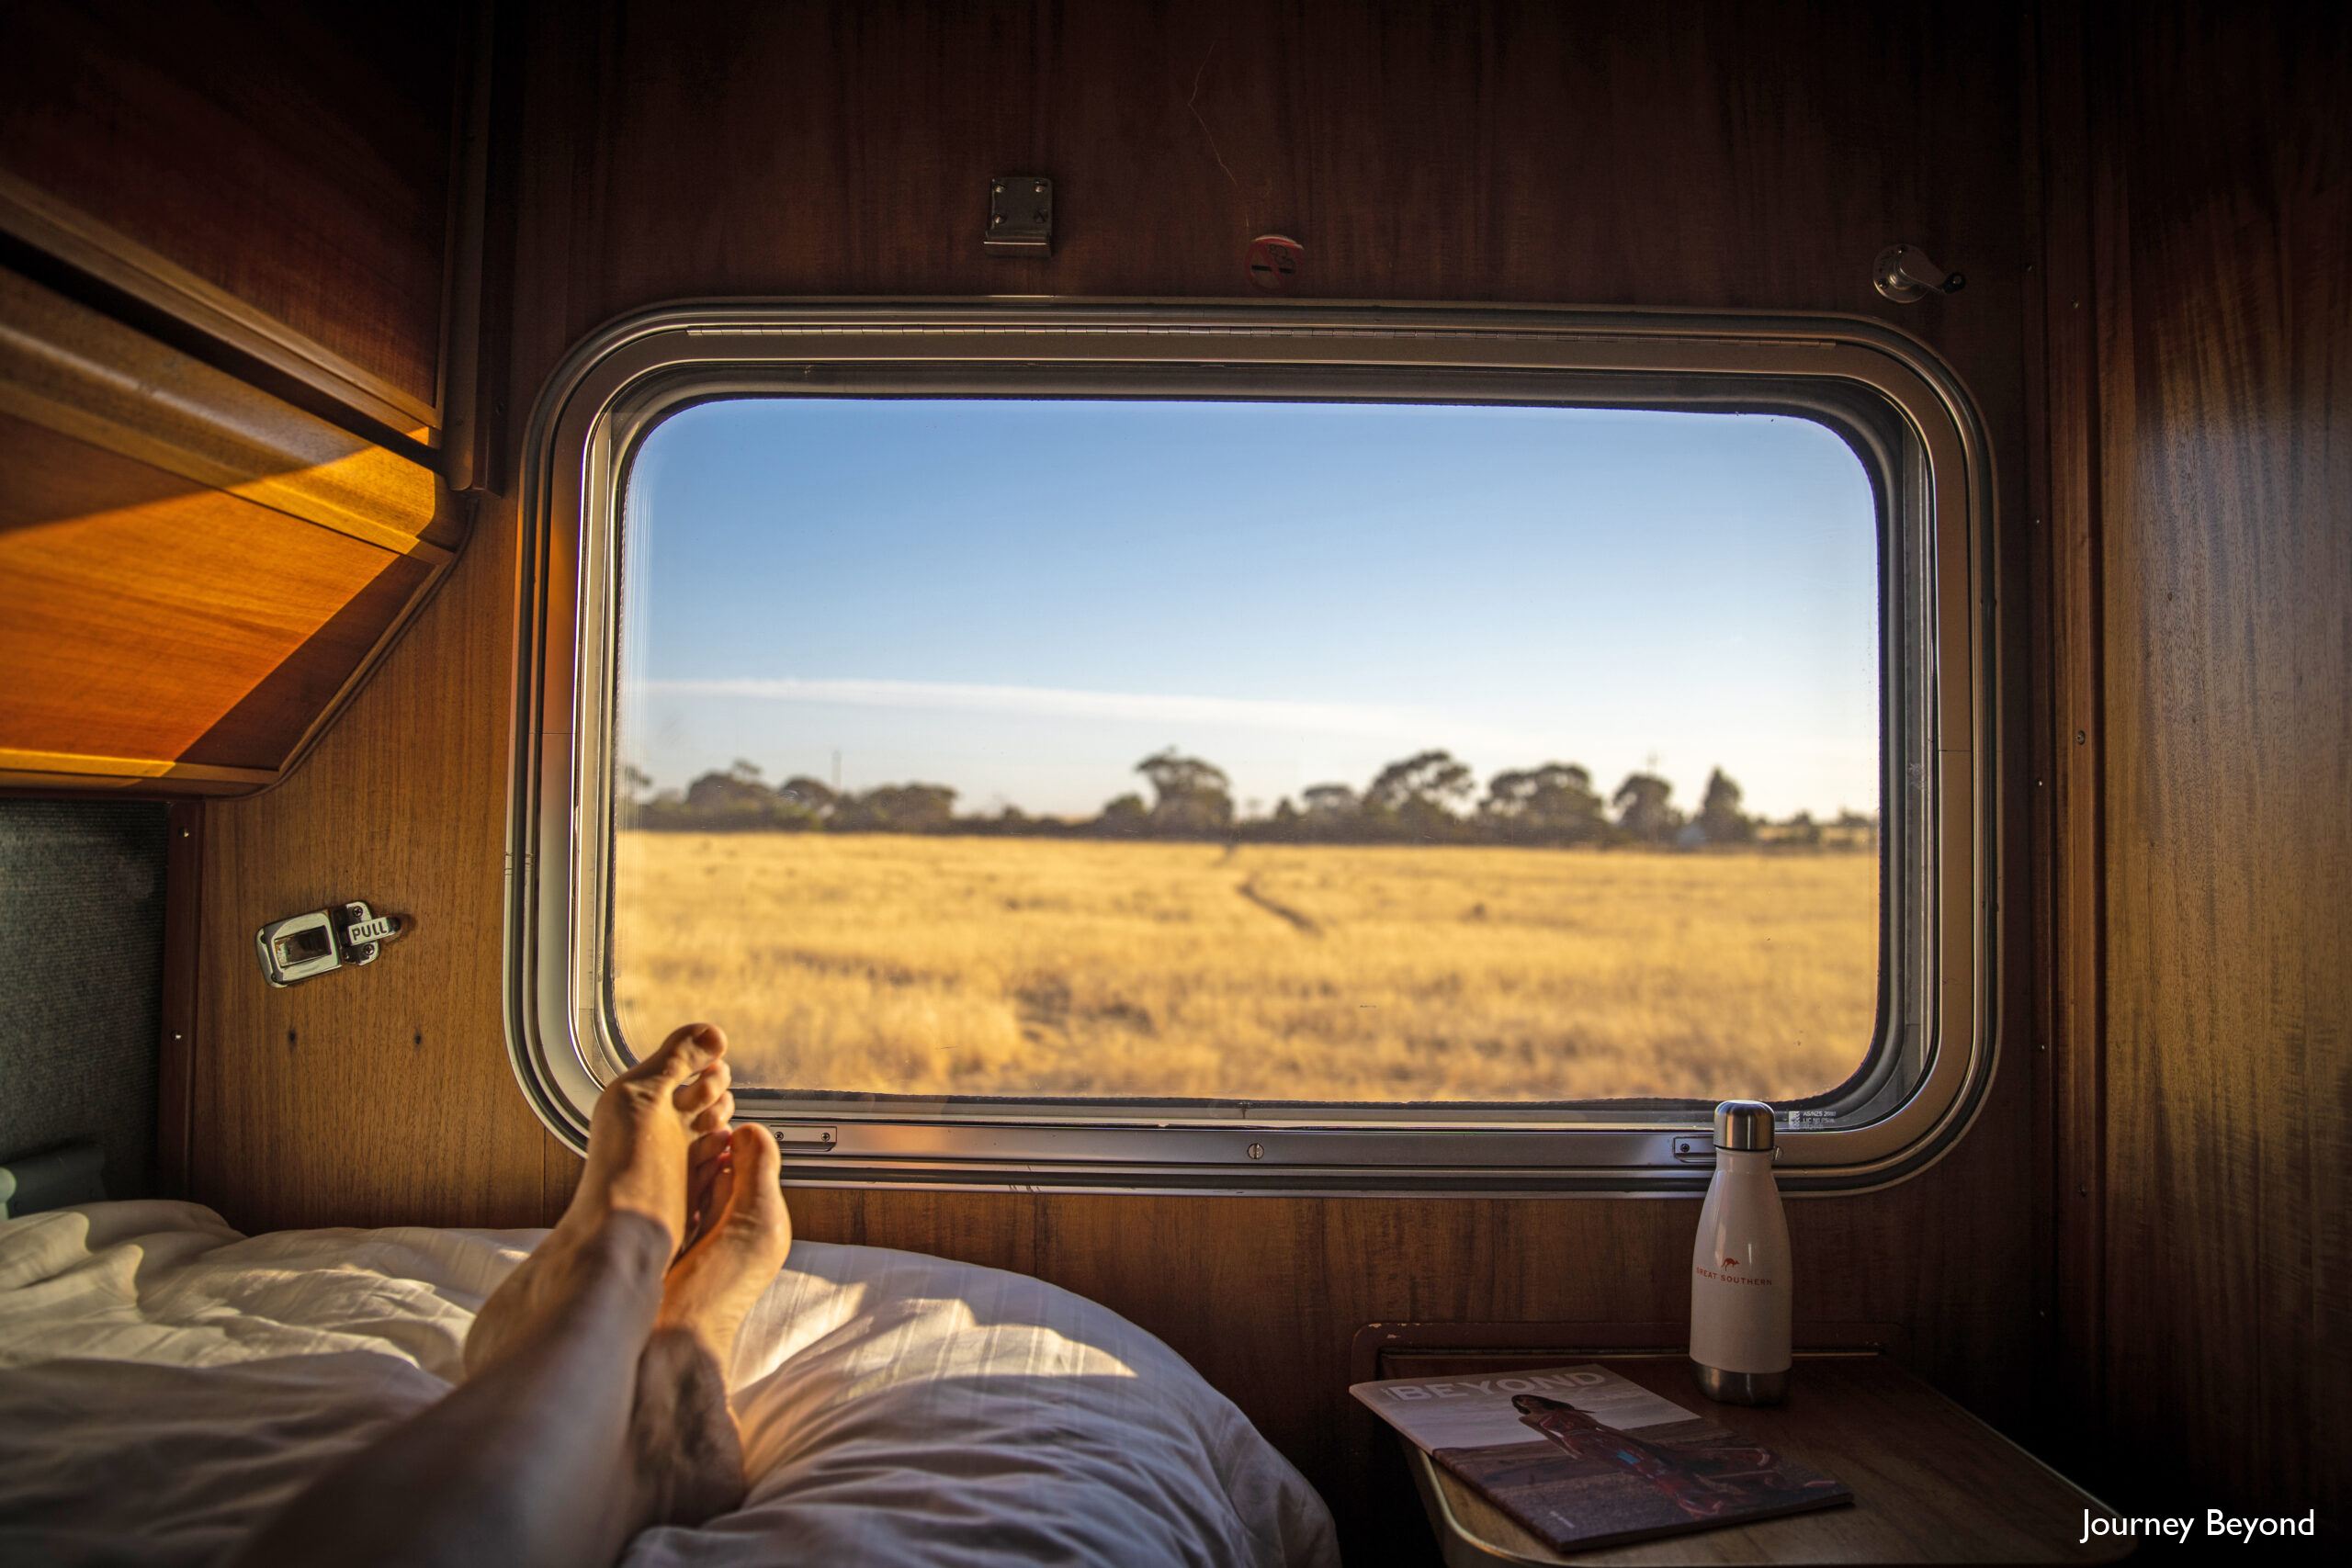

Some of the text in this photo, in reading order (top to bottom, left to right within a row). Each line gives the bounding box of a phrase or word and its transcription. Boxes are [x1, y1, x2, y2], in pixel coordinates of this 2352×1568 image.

[352, 921, 387, 941] PULL
[1721, 1274, 1772, 1286] SOUTHERN
[1392, 1371, 1604, 1402] BEYOND
